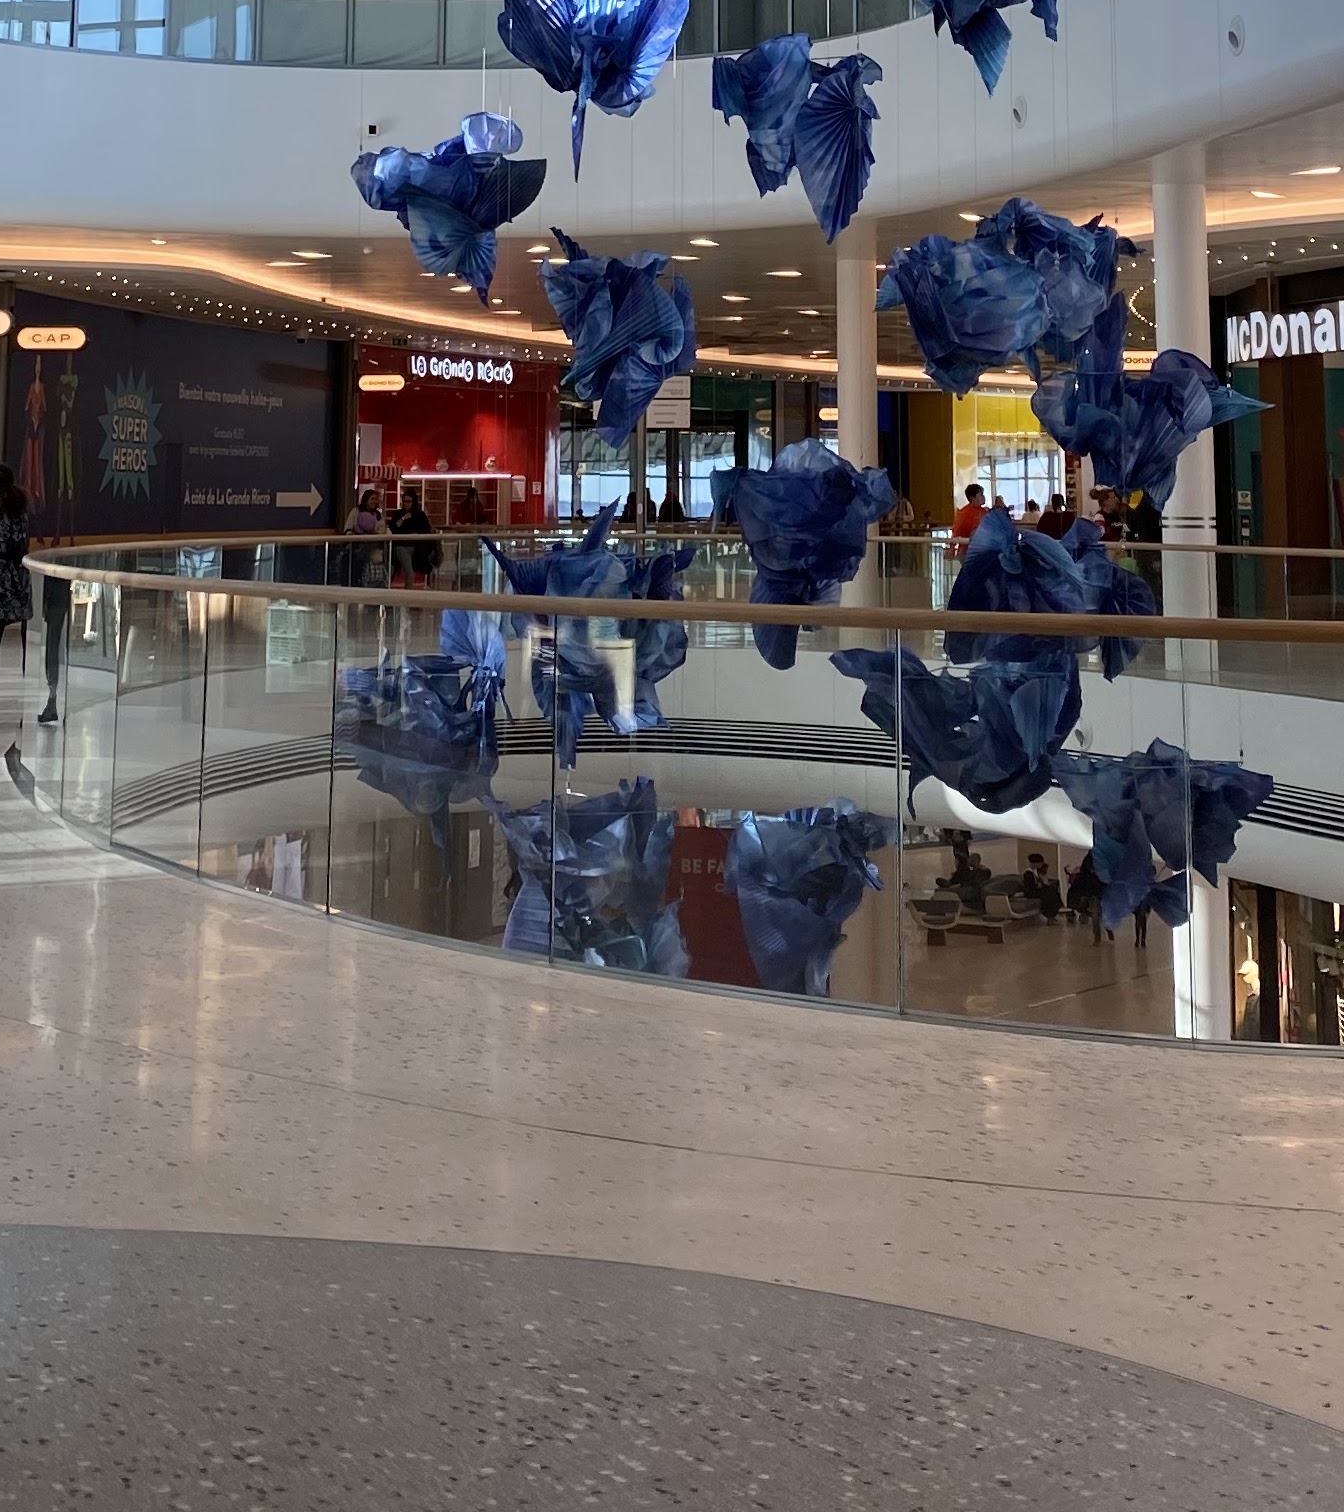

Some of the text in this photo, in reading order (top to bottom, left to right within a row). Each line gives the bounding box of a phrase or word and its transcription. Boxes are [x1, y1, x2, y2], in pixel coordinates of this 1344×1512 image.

[31, 333, 71, 344] CAP
[411, 355, 514, 385] La Grande Récré
[112, 415, 148, 443] SUPER
[112, 447, 148, 472] HEROS
[206, 489, 215, 505] de
[216, 488, 225, 505] La
[681, 858, 703, 874] BE
